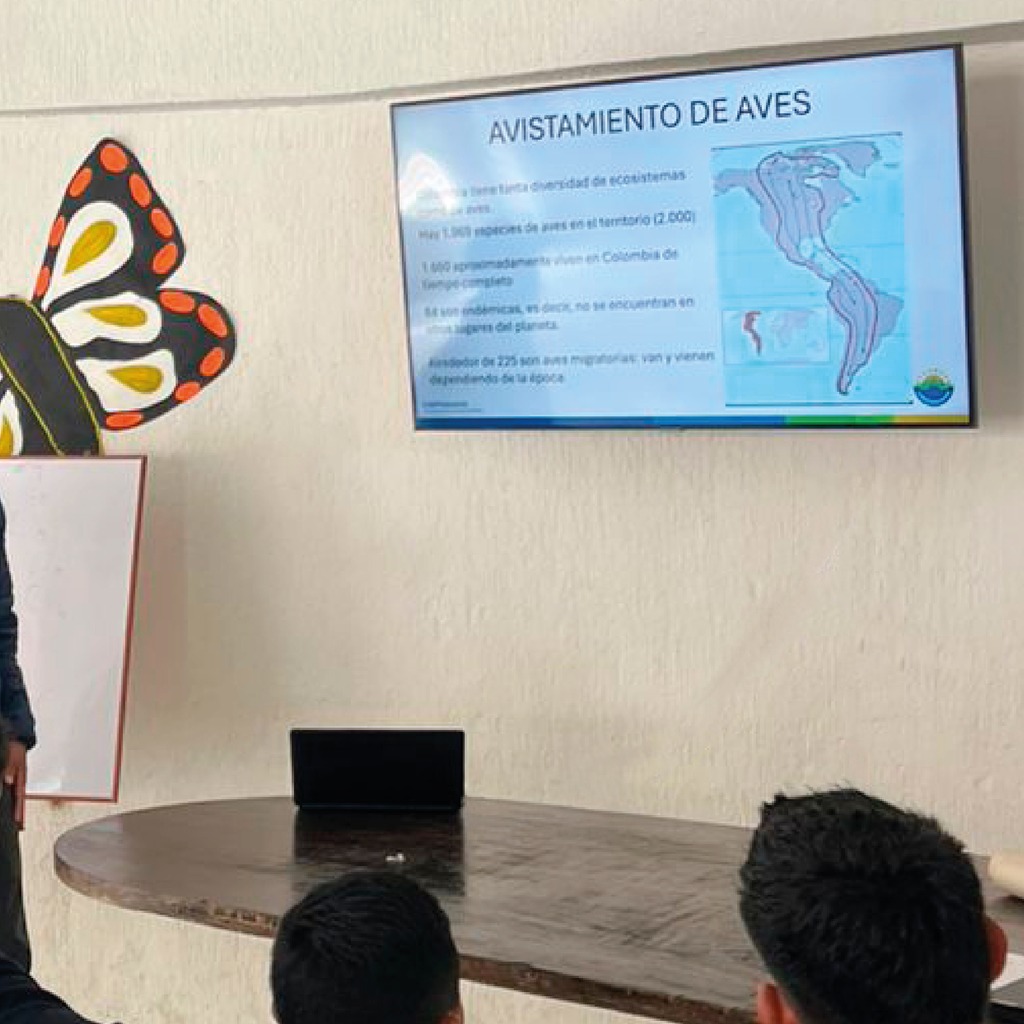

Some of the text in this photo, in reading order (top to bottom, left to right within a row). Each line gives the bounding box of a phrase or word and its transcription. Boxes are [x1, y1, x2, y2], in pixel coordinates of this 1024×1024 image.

[488, 88, 812, 145] AVISTAMIENTO DE AVES
[530, 175, 590, 192] diversidad
[592, 175, 606, 187] de
[609, 168, 687, 186] ecosistemas
[474, 223, 522, 239] especies
[524, 220, 539, 233] de
[541, 220, 567, 232] aves
[570, 219, 584, 230] en
[586, 217, 597, 229] el
[598, 213, 651, 229] territorio
[653, 207, 696, 227] (2.000)
[585, 253, 600, 264] en
[602, 248, 661, 264] Colombia
[662, 248, 678, 261] de
[461, 275, 514, 291] completo
[575, 301, 590, 312] no
[593, 300, 606, 311] se
[608, 296, 677, 311] encuentran
[678, 296, 695, 309] en
[495, 321, 512, 333] del
[481, 355, 495, 367] de
[496, 354, 517, 367] 225
[519, 355, 539, 367] son
[641, 351, 663, 364] van
[675, 350, 716, 363] vienen
[429, 373, 498, 387] dependiendo
[500, 372, 515, 384] de
[516, 372, 527, 383] la
